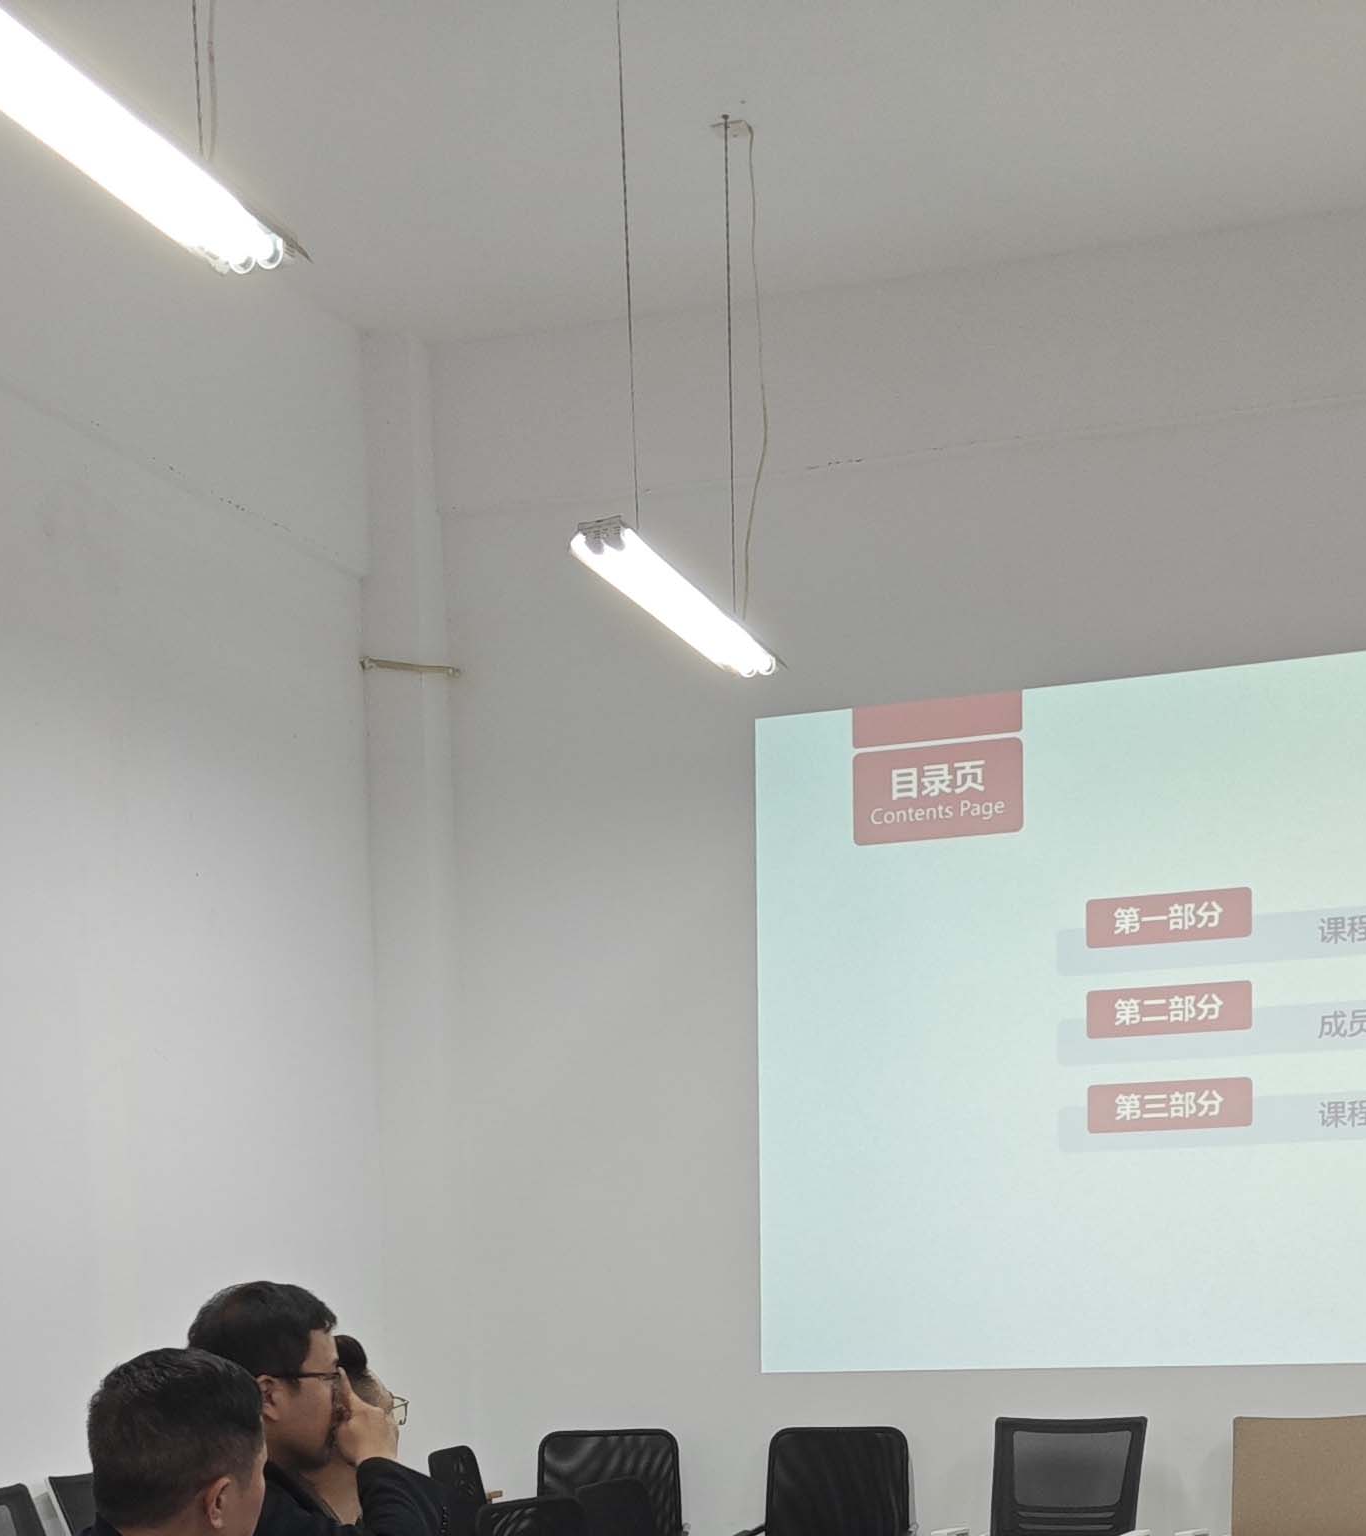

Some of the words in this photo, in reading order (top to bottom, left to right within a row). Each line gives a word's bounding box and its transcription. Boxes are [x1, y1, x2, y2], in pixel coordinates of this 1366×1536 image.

[891, 760, 985, 801] 目录页
[870, 803, 953, 825] Contents
[960, 800, 1005, 820] Page
[1113, 902, 1223, 935] 第一部分
[1113, 994, 1223, 1027] 第二部分
[1114, 1090, 1224, 1122] 第三部分
